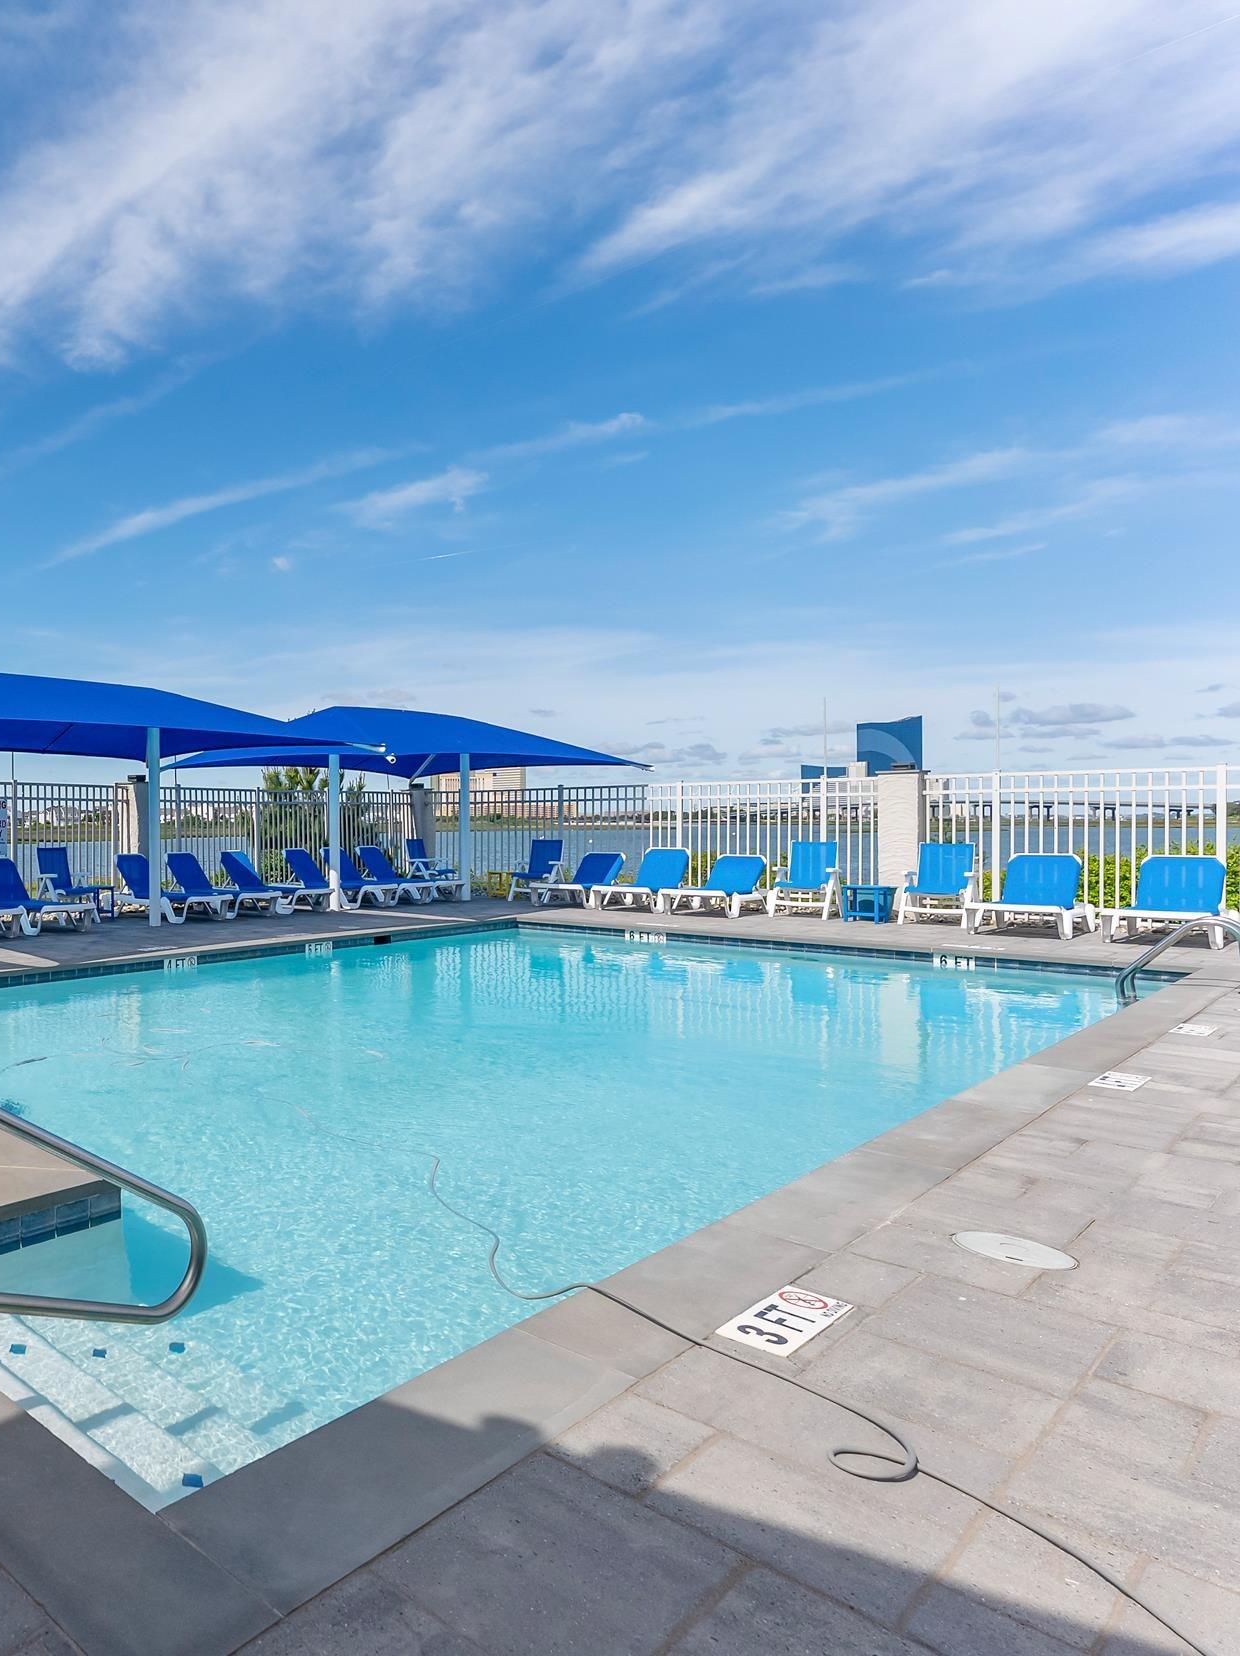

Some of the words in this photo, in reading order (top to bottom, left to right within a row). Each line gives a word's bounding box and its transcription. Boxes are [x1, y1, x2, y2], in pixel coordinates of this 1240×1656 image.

[940, 954, 947, 965] 6
[753, 1303, 817, 1333] FT
[737, 1324, 789, 1346] 3
